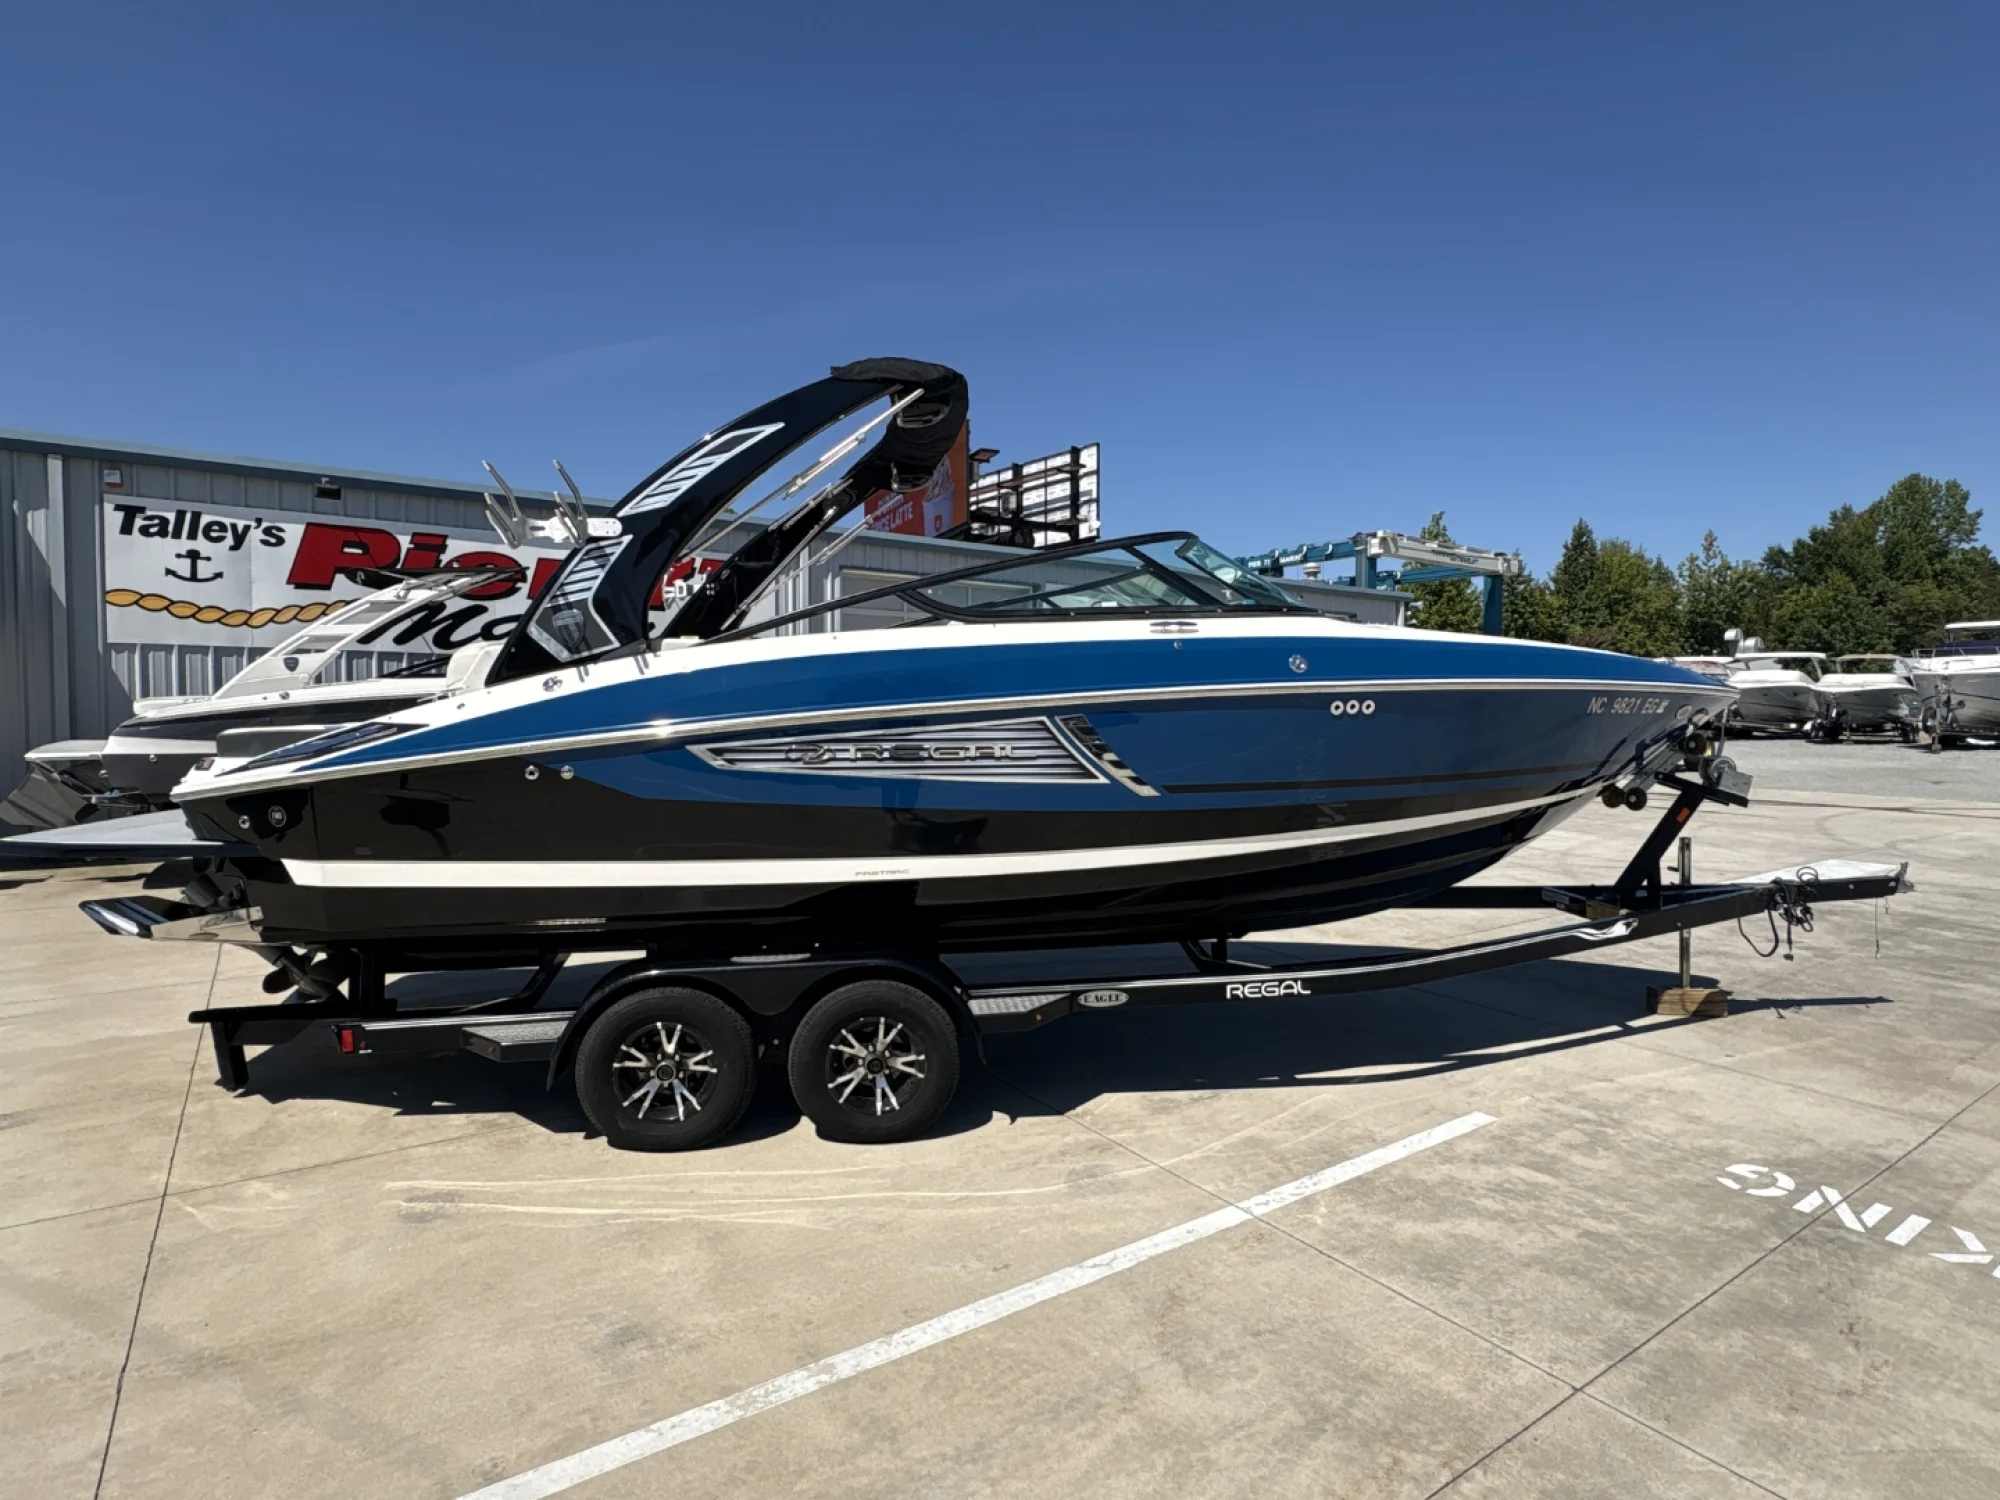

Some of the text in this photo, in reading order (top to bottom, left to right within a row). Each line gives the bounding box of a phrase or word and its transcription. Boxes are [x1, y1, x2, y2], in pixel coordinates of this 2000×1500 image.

[113, 504, 286, 551] Talley's
[1587, 697, 1607, 714] NC
[851, 743, 1038, 761] REGAL
[1226, 980, 1311, 999] REGAL
